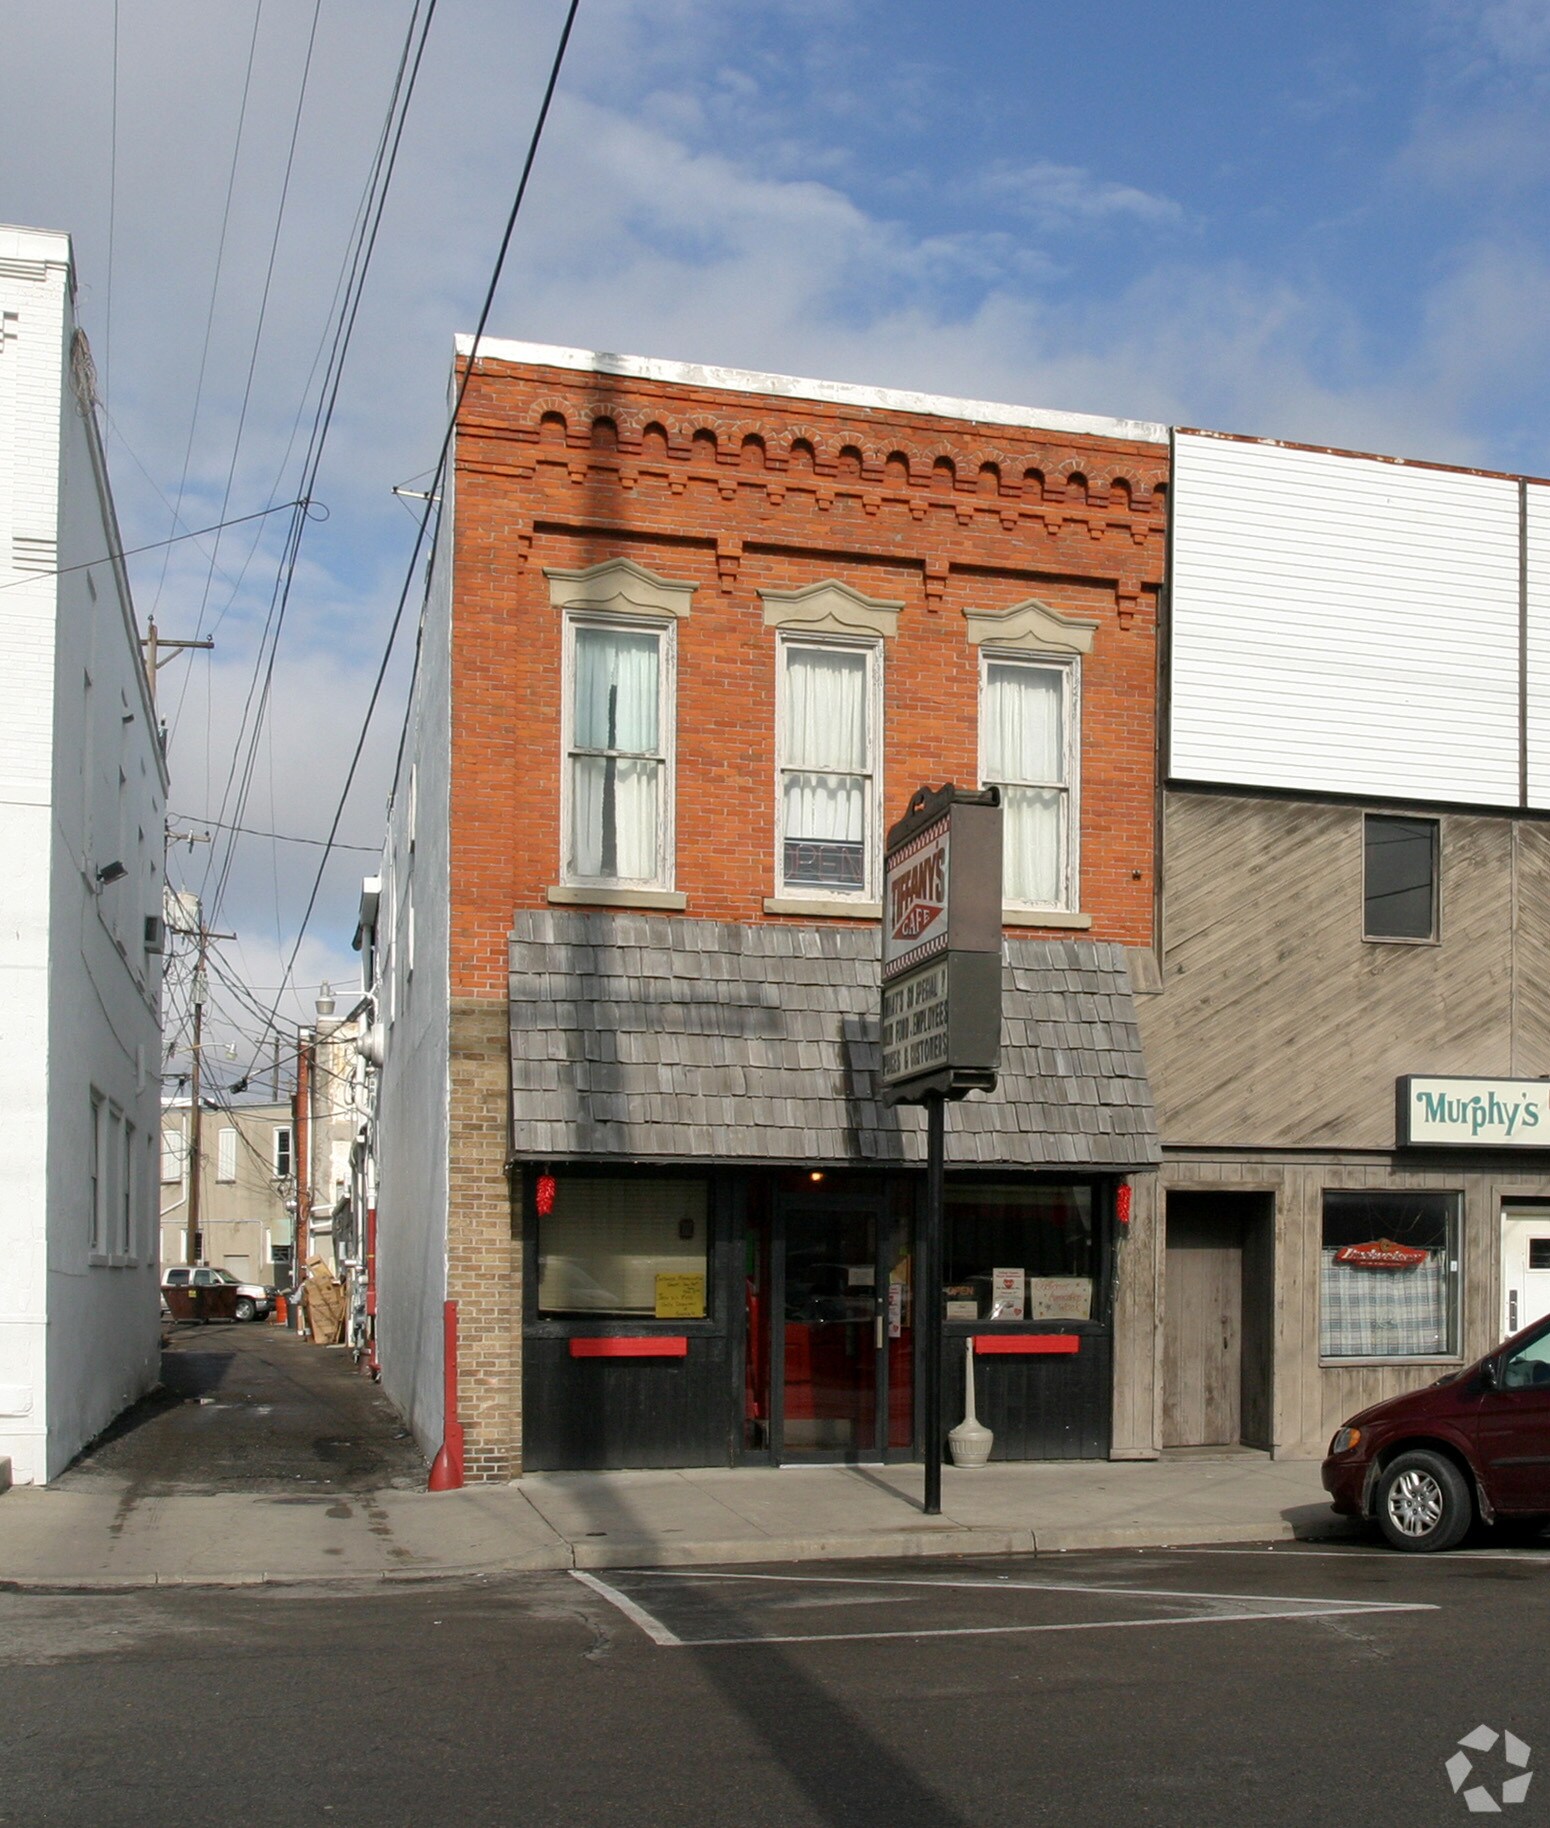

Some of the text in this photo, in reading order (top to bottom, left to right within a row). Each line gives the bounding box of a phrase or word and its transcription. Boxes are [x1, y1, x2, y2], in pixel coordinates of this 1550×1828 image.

[891, 840, 946, 933] TIFFANY'S
[902, 908, 931, 935] CAFE
[1416, 1091, 1539, 1136] Murphy's
